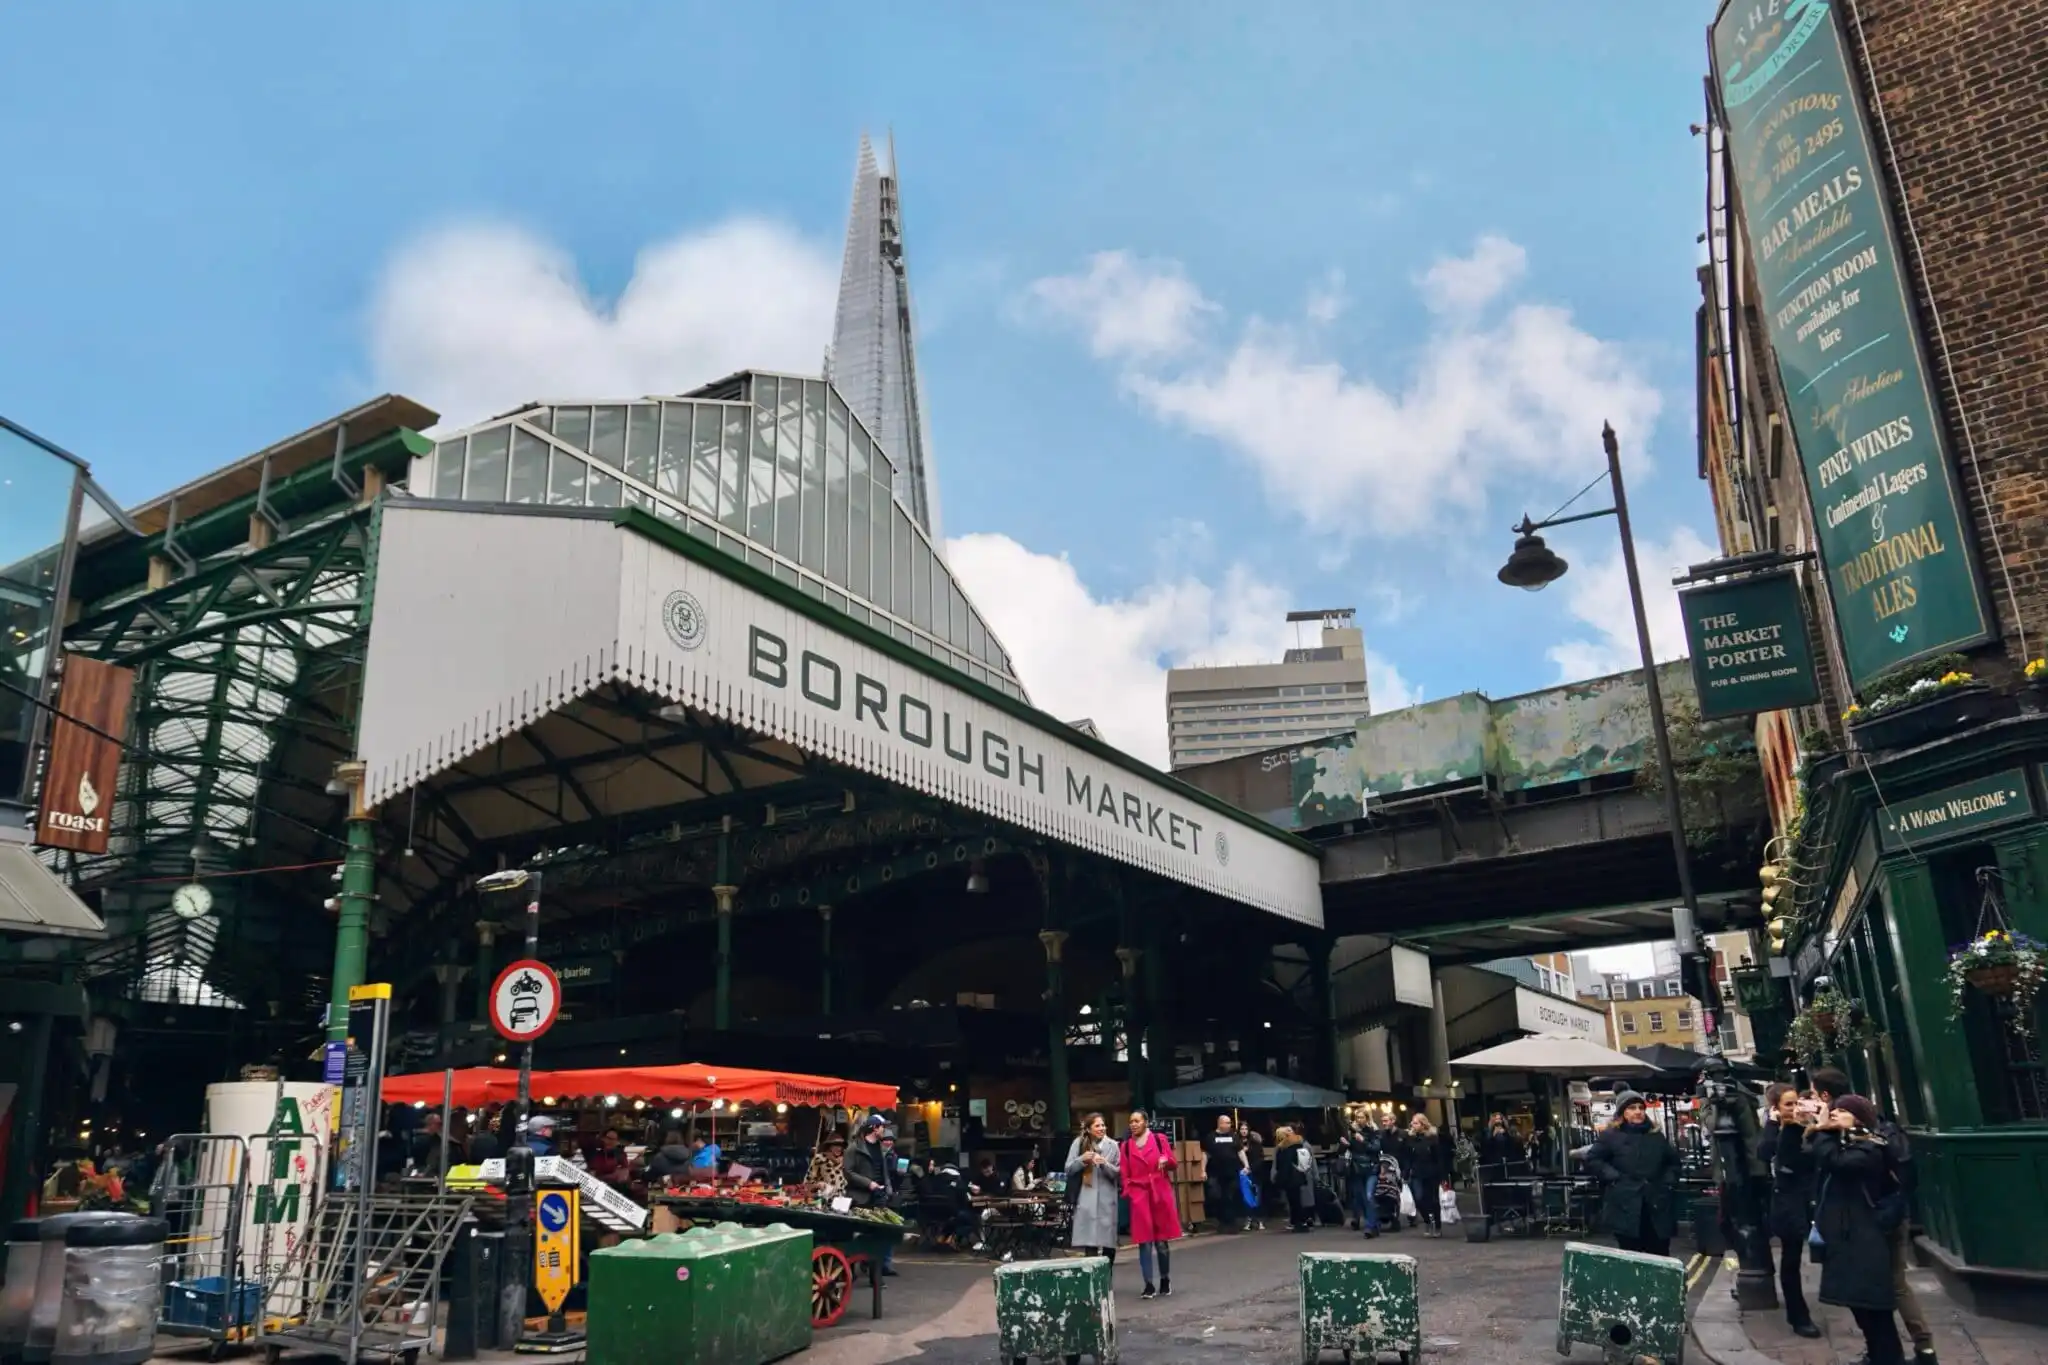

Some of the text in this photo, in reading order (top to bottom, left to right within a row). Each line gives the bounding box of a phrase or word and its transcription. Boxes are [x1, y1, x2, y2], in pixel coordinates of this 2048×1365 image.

[1734, 0, 1780, 46] THE
[1804, 116, 1844, 155] 2495
[1760, 221, 1793, 261] BAR
[1791, 166, 1863, 233] MEALS
[1776, 246, 1879, 329] FUNCTION ROOM
[1796, 288, 1862, 343] available for
[1818, 328, 1843, 352] hire
[1818, 415, 1914, 489] FINE WINES
[1825, 462, 1928, 529] Continental Lagers
[1839, 521, 1946, 596] TRADITIONAL
[1699, 612, 1739, 631] THE
[1872, 575, 1918, 623] ALES
[1703, 624, 1782, 650] MARKET
[1707, 644, 1787, 669] PORTER
[1711, 679, 1729, 688] PUB
[1739, 672, 1770, 682] DINING
[1771, 667, 1798, 677] ROOM
[749, 624, 1203, 855] BOROUGH MARKET
[48, 810, 104, 832] roast
[1899, 790, 2007, 833] A WARM WELCOME
[1540, 1005, 1591, 1032] BOROUGH MARKET
[252, 1096, 305, 1224] ATM
